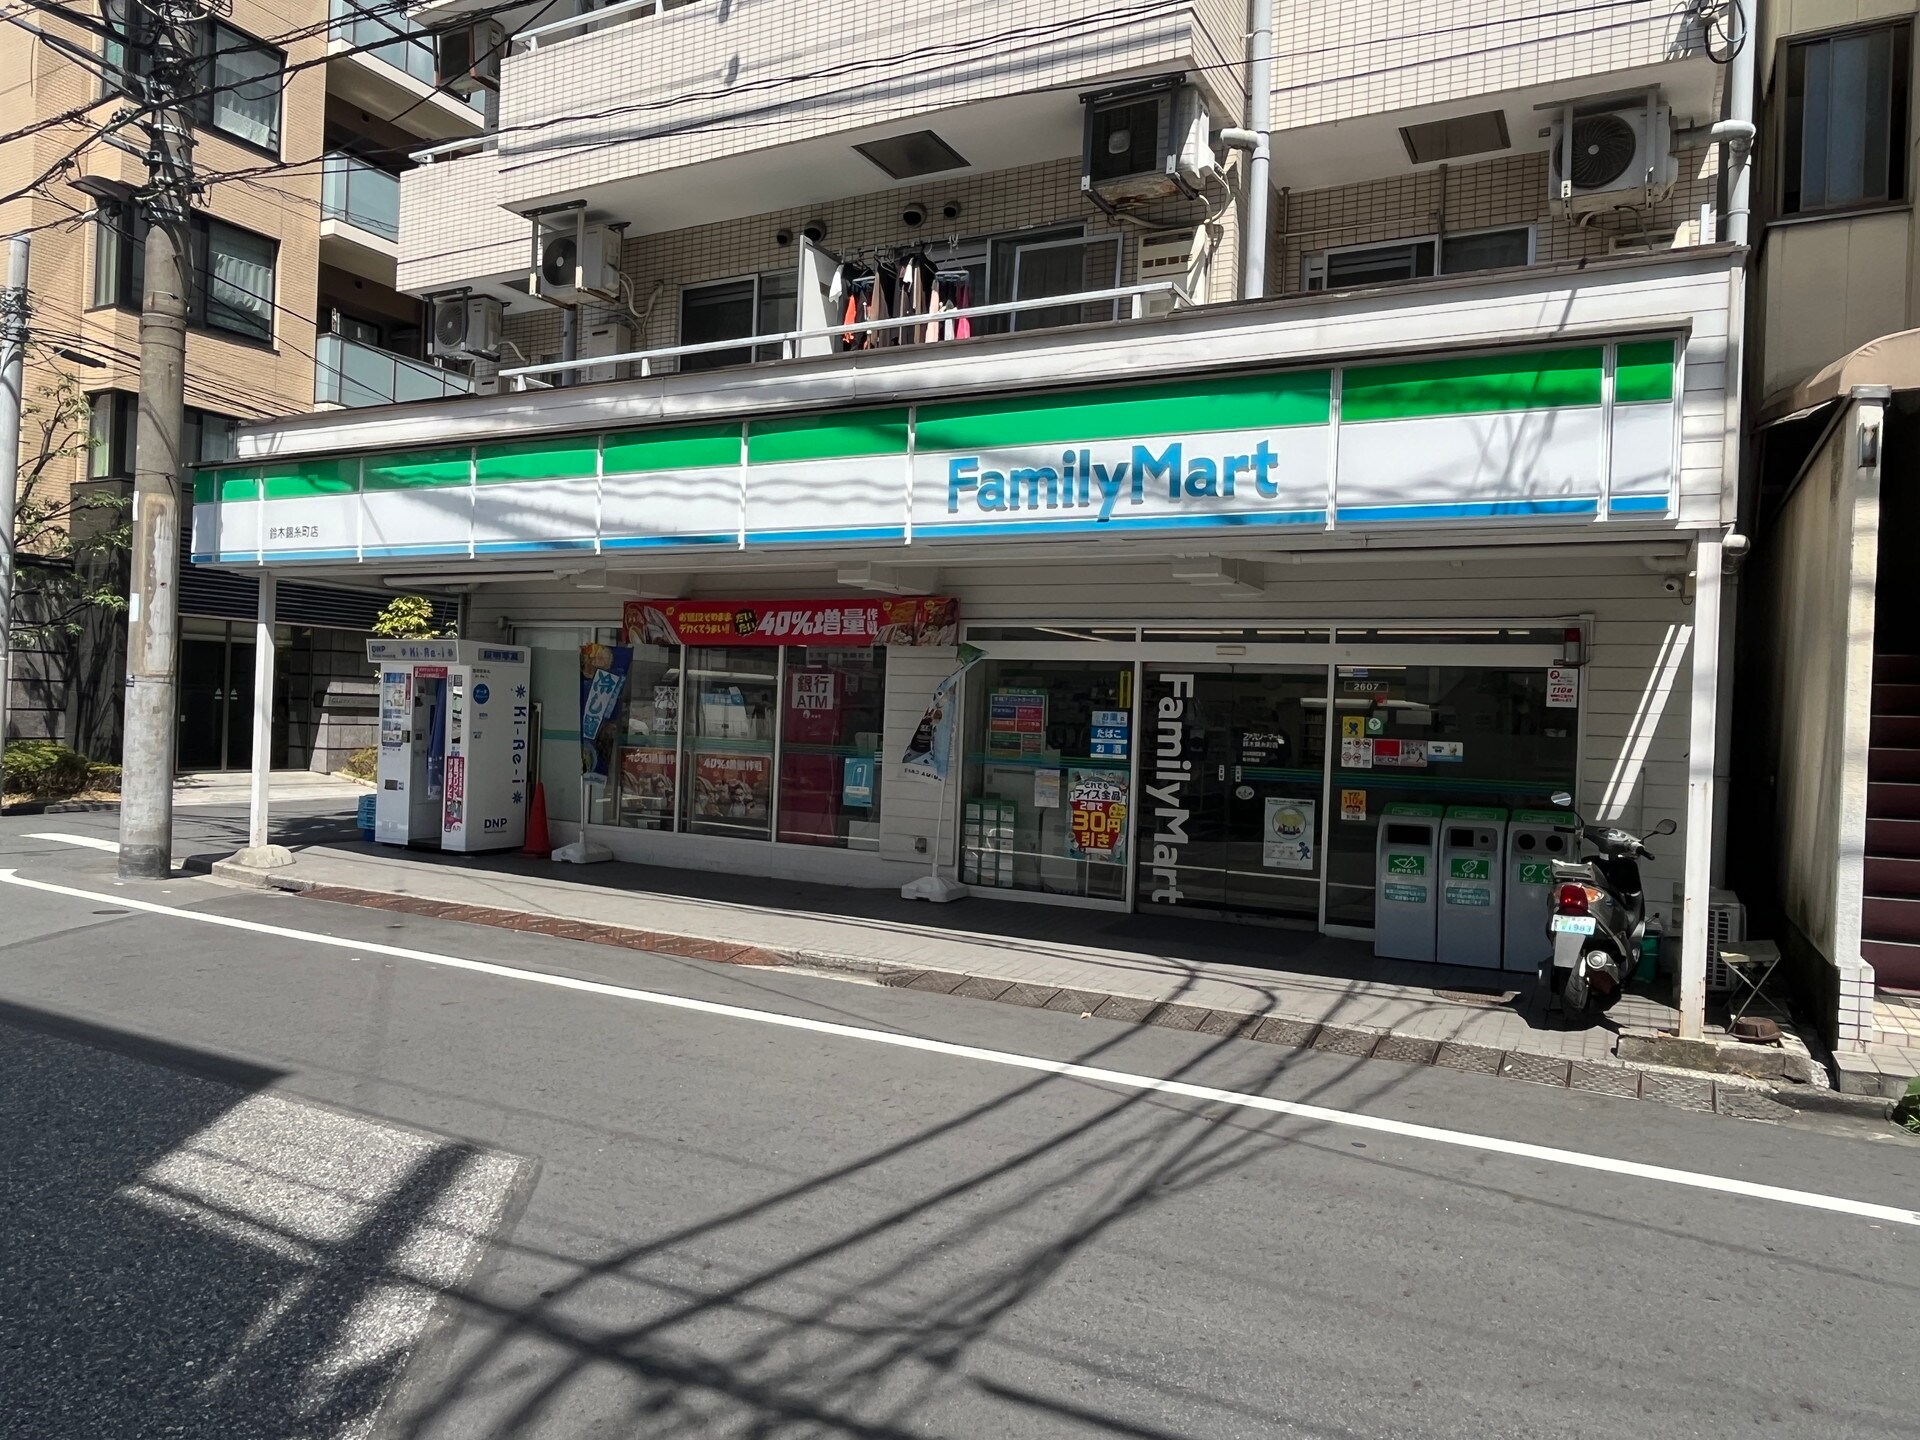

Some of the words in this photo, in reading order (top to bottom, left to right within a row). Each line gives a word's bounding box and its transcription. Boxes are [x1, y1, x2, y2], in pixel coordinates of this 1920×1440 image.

[947, 440, 1279, 522] FamilyMart
[757, 608, 866, 636] 40%増量
[798, 675, 830, 693] 銀行
[797, 695, 828, 708] ATM
[1097, 729, 1122, 739] たばこ
[512, 706, 527, 783] Ki-Re-i
[1075, 789, 1121, 801] アイス全品
[1146, 673, 1195, 904] FamilyMart
[484, 818, 508, 829] DNP
[1072, 810, 1121, 833] 30円
[1081, 831, 1110, 848] 引き
